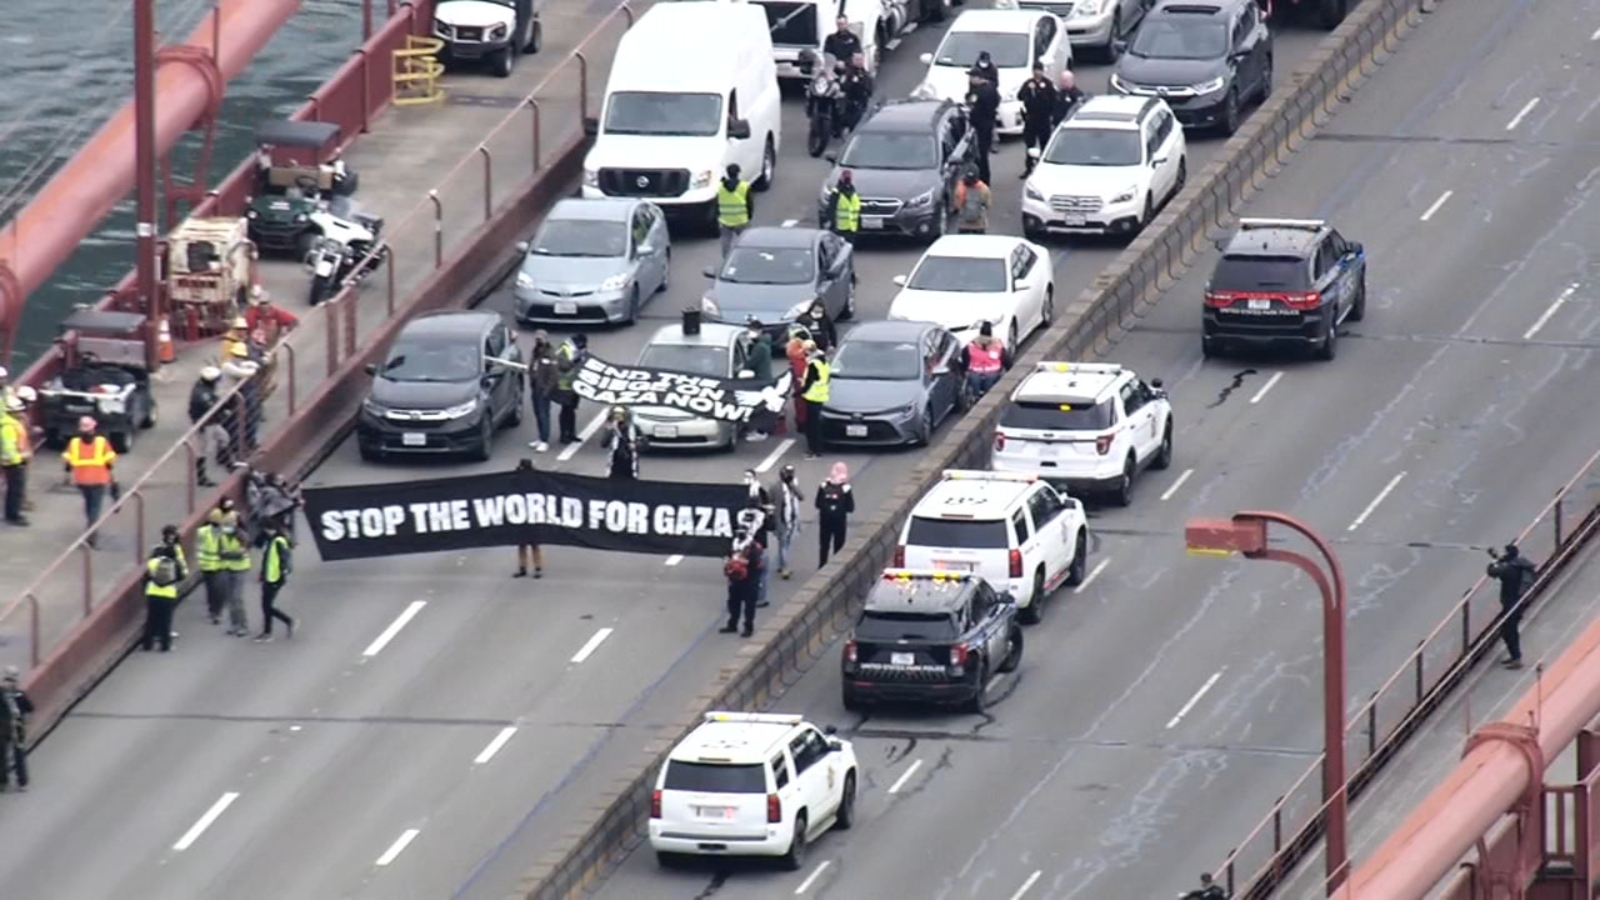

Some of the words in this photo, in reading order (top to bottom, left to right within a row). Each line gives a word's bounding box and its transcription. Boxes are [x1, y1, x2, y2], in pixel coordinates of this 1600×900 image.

[578, 369, 671, 393] SIEGE
[675, 384, 726, 401] ON
[584, 357, 652, 381] END
[657, 372, 721, 389] THE
[571, 380, 659, 404] GAZA
[663, 392, 754, 423] NOW!
[320, 505, 405, 542] STOP
[408, 500, 472, 533] THE
[472, 492, 583, 530] WORLD
[588, 499, 650, 534] FOR
[653, 504, 734, 539] GAZA
